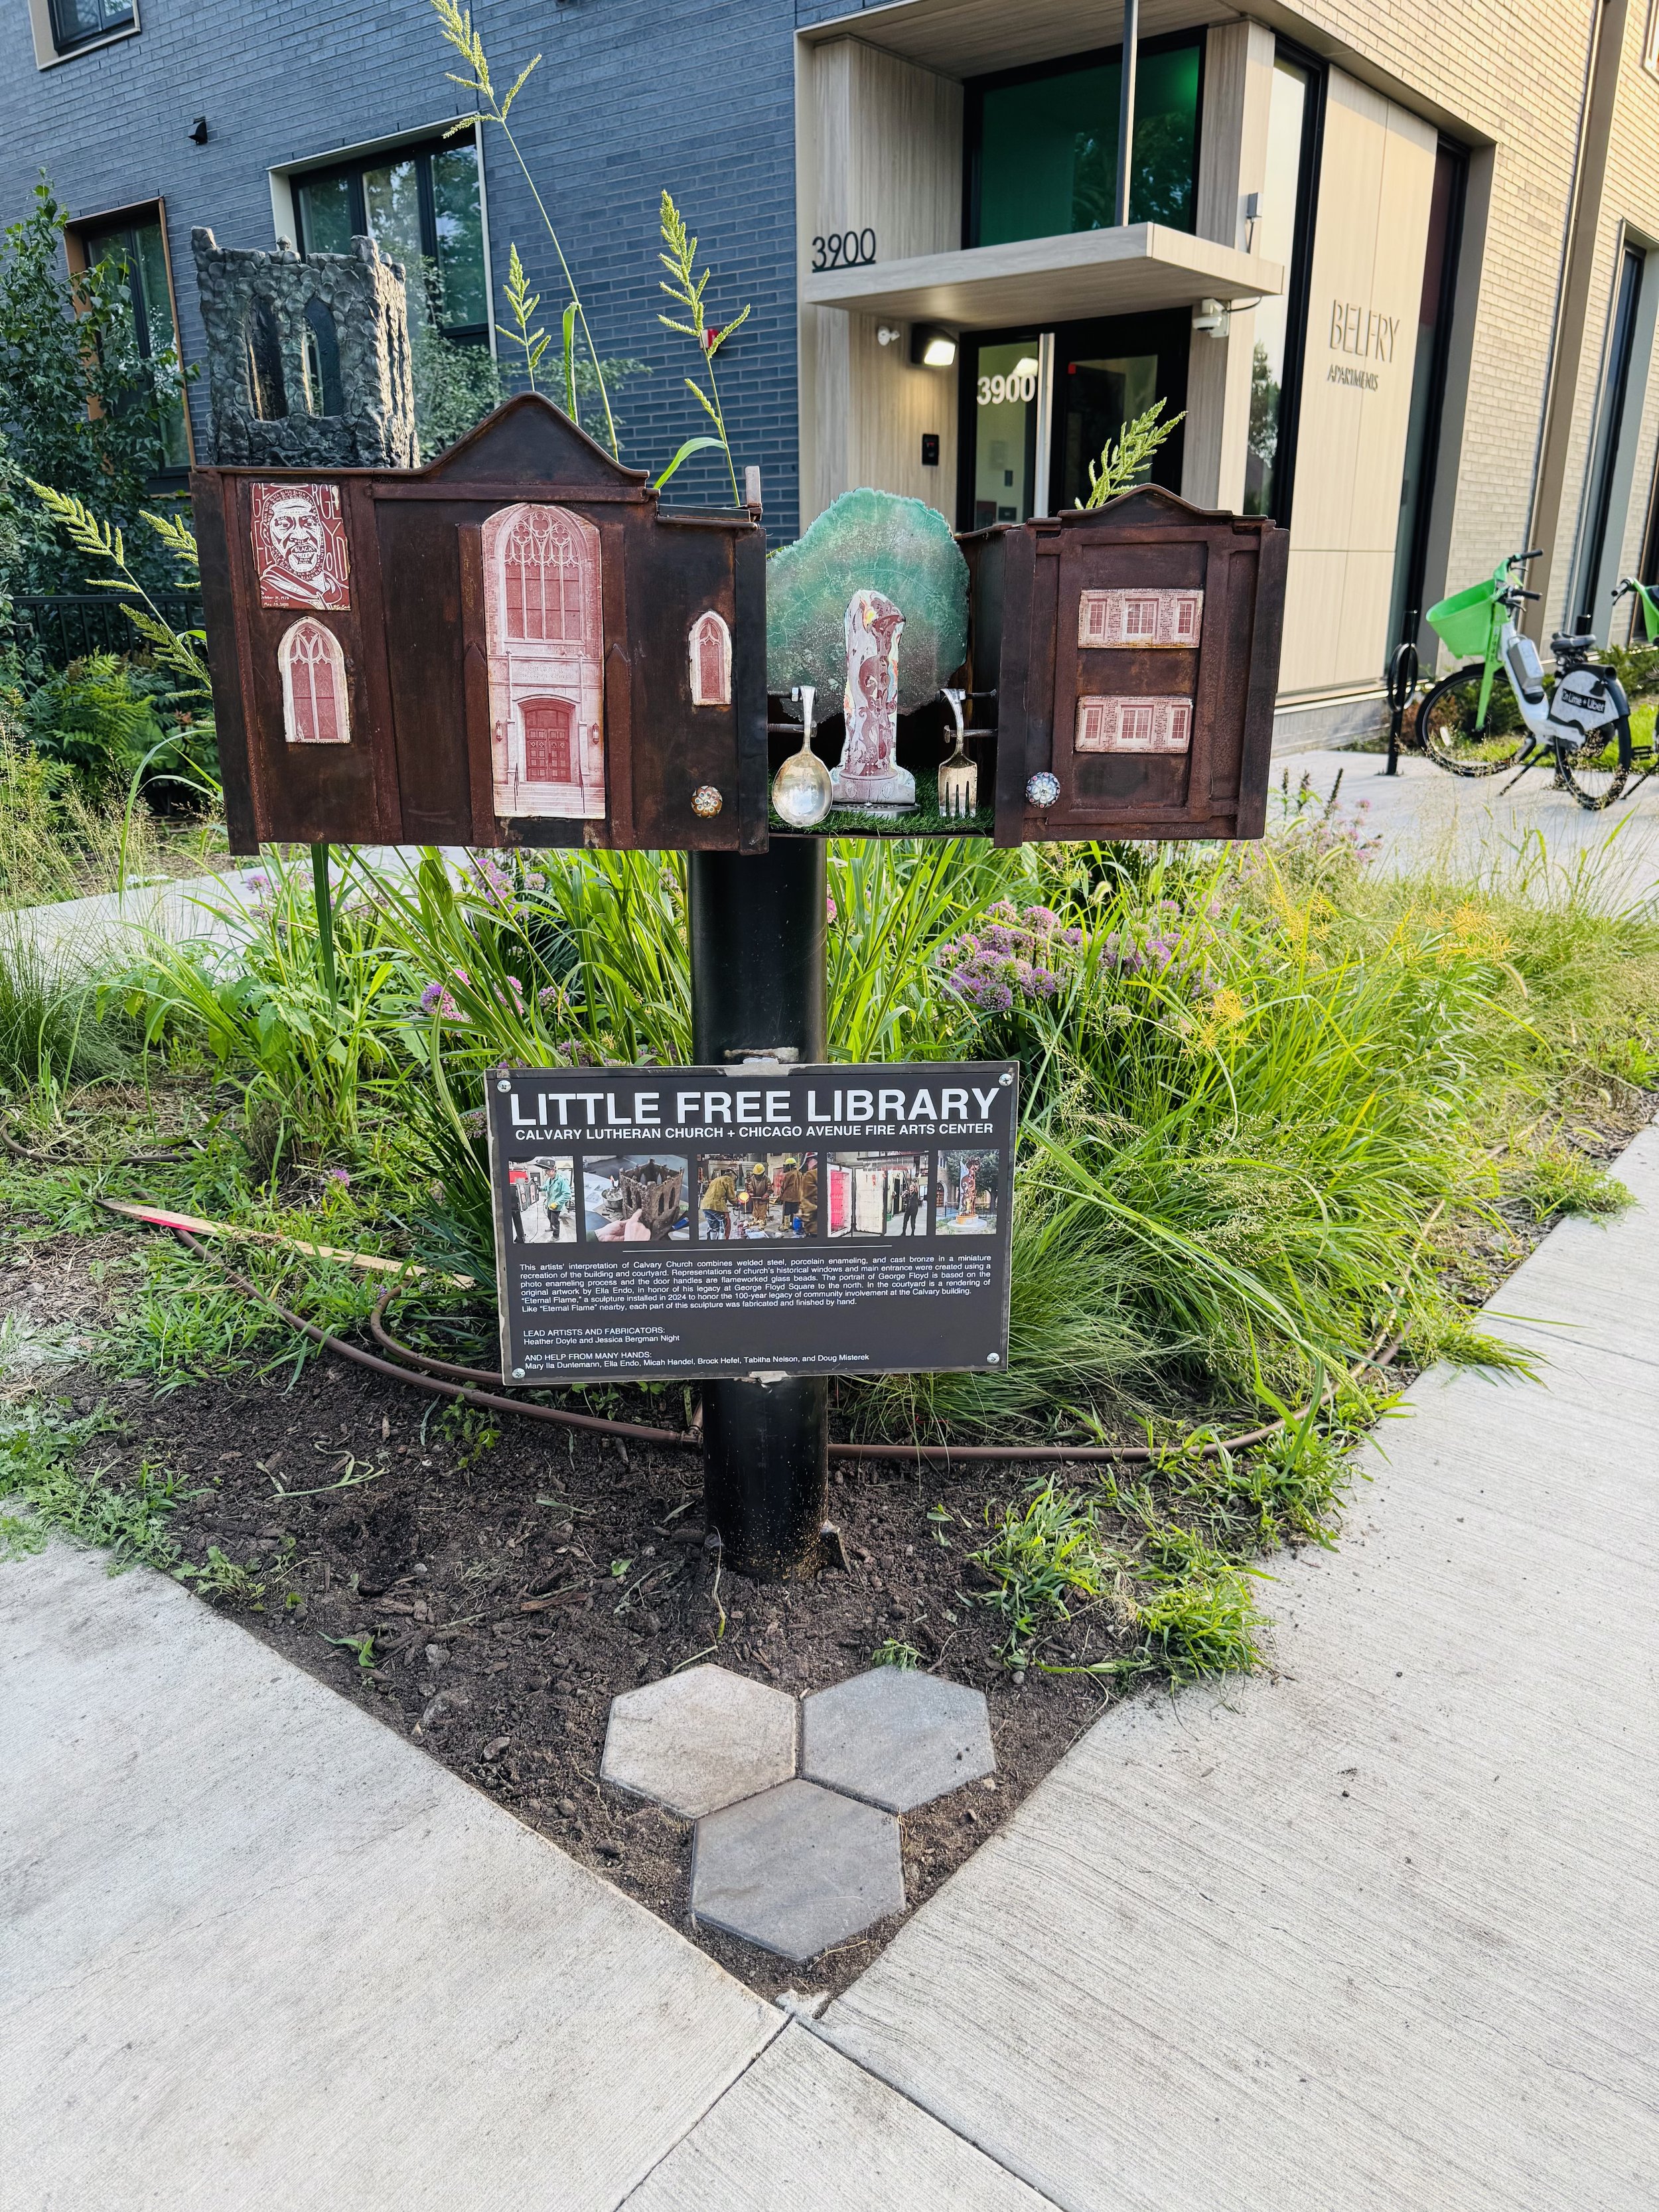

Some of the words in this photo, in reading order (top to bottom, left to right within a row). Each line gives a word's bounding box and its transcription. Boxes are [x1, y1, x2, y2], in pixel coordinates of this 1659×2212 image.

[812, 228, 875, 269] 3900
[1330, 299, 1400, 363] BELFRY
[1327, 364, 1379, 392] APARTMENTS
[977, 374, 1035, 405] 3900
[1587, 698, 1605, 712] Uber
[510, 1091, 661, 1125] LITTLE
[676, 1090, 791, 1123] FREE
[808, 1088, 999, 1122] LIBRARY
[515, 1128, 582, 1140] CALVARY
[586, 1127, 661, 1139] LUTHERAN
[665, 1126, 723, 1138] CHURCH
[739, 1125, 802, 1137] CHICAGO
[806, 1124, 861, 1136] AVENUE
[865, 1124, 895, 1135] FIRE
[899, 1123, 935, 1134] ARTS
[938, 1122, 993, 1134] CENTER
[569, 1262, 618, 1272] interpretation
[633, 1260, 662, 1270] Calvary
[766, 1258, 786, 1267] steel,
[790, 1257, 824, 1266] porcelain
[828, 1256, 868, 1266] enameling,
[584, 1270, 613, 1279] building
[632, 1269, 669, 1278] courtyard.
[672, 1268, 732, 1278] Representations
[964, 1262, 984, 1271] using
[520, 1280, 542, 1289] photo
[545, 1279, 584, 1288] enameling
[587, 1279, 617, 1288] process
[770, 1274, 790, 1284] glass
[839, 1273, 865, 1282] portrait
[878, 1272, 905, 1281] George
[908, 1271, 928, 1280] Floyd
[591, 1294, 624, 1304] sculpture
[735, 1291, 767, 1301] 100-year
[768, 1291, 792, 1300] legacy
[803, 1290, 843, 1299] community
[912, 1288, 940, 1297] Calvary
[942, 1286, 972, 1296] building.
[599, 1303, 627, 1312] nearby,
[649, 1302, 664, 1311] part
[689, 1301, 723, 1310] sculpture
[826, 1298, 835, 1307] by
[555, 1337, 577, 1346] Doyle
[624, 1334, 658, 1344] Bergman
[660, 1333, 680, 1343] Night
[605, 1326, 665, 1335] FABRICATORS:
[525, 1362, 543, 1371] Mary
[557, 1360, 602, 1370] Duntemann,
[620, 1359, 641, 1368] Endo,
[667, 1357, 695, 1367] Handel,
[720, 1357, 741, 1365] Hefel,
[772, 1355, 800, 1364] Nelson,
[818, 1354, 837, 1363] Doug
